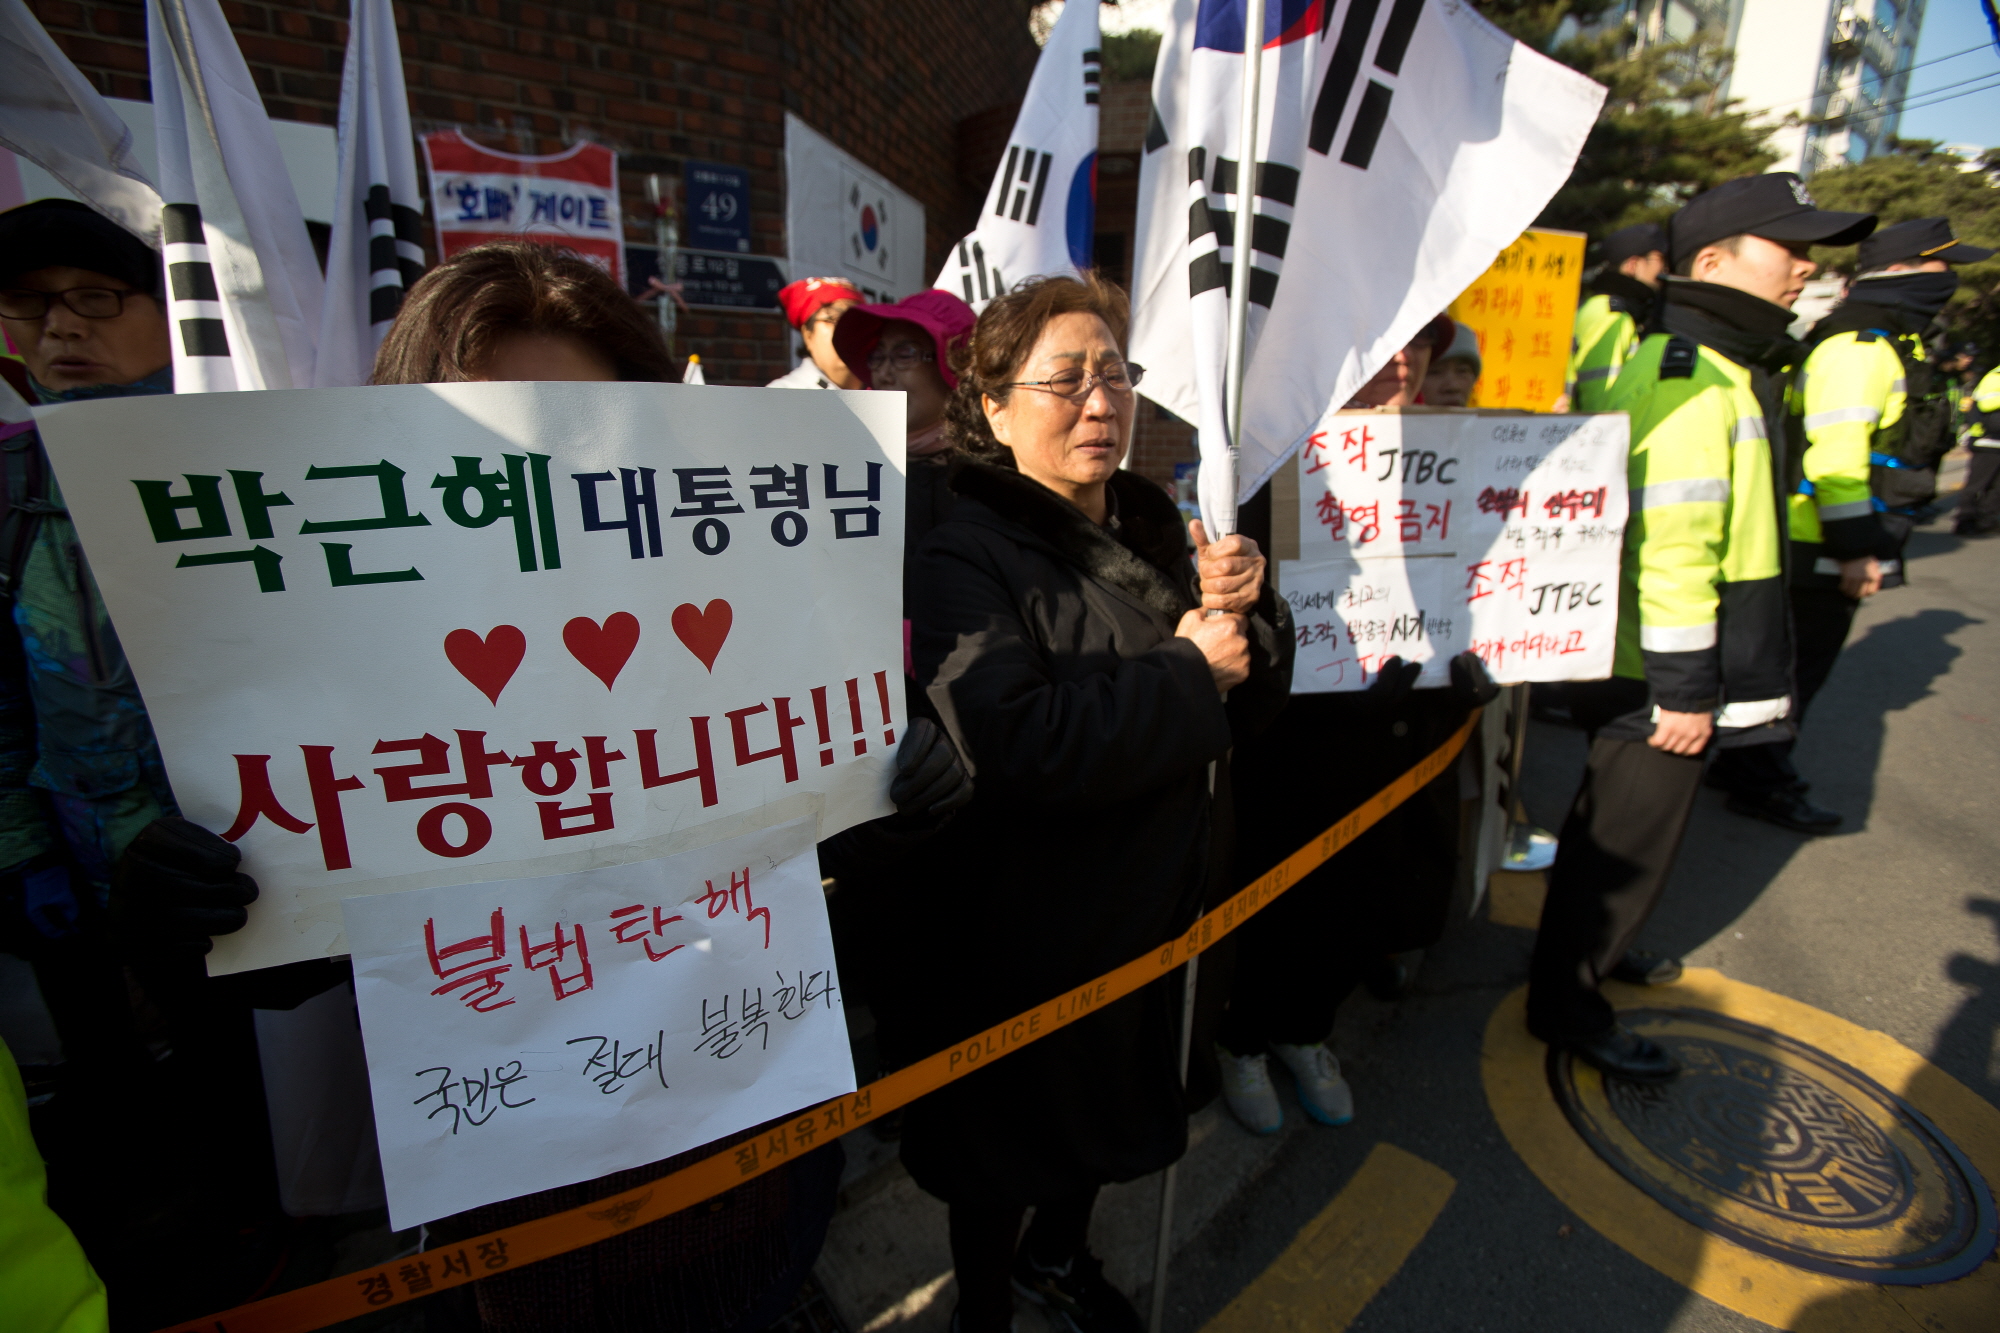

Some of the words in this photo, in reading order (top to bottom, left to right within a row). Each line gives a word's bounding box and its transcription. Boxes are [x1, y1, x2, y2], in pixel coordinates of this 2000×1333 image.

[530, 189, 610, 230] 게이트
[700, 191, 738, 222] 49
[1303, 425, 1375, 475] 조작
[1378, 448, 1460, 484] JTBC
[131, 452, 562, 592] 박근혜
[571, 461, 884, 560] 대통령님
[1315, 490, 1381, 543] 촬영
[1394, 499, 1452, 543] 금지
[1465, 557, 1529, 606] 조작
[1530, 581, 1603, 615] JTBC
[221, 669, 897, 872] 사랑합니다!!!
[424, 906, 594, 1013] 불법
[608, 866, 772, 962] 탄핵
[1186, 916, 1213, 955] 선을
[949, 1012, 1042, 1073] POLICE
[1056, 980, 1109, 1023] LINE
[413, 1060, 535, 1135] 국민은
[566, 1030, 669, 1095] 절대
[734, 1090, 874, 1175] 질서유지선
[357, 1236, 511, 1306] 경찰서장
